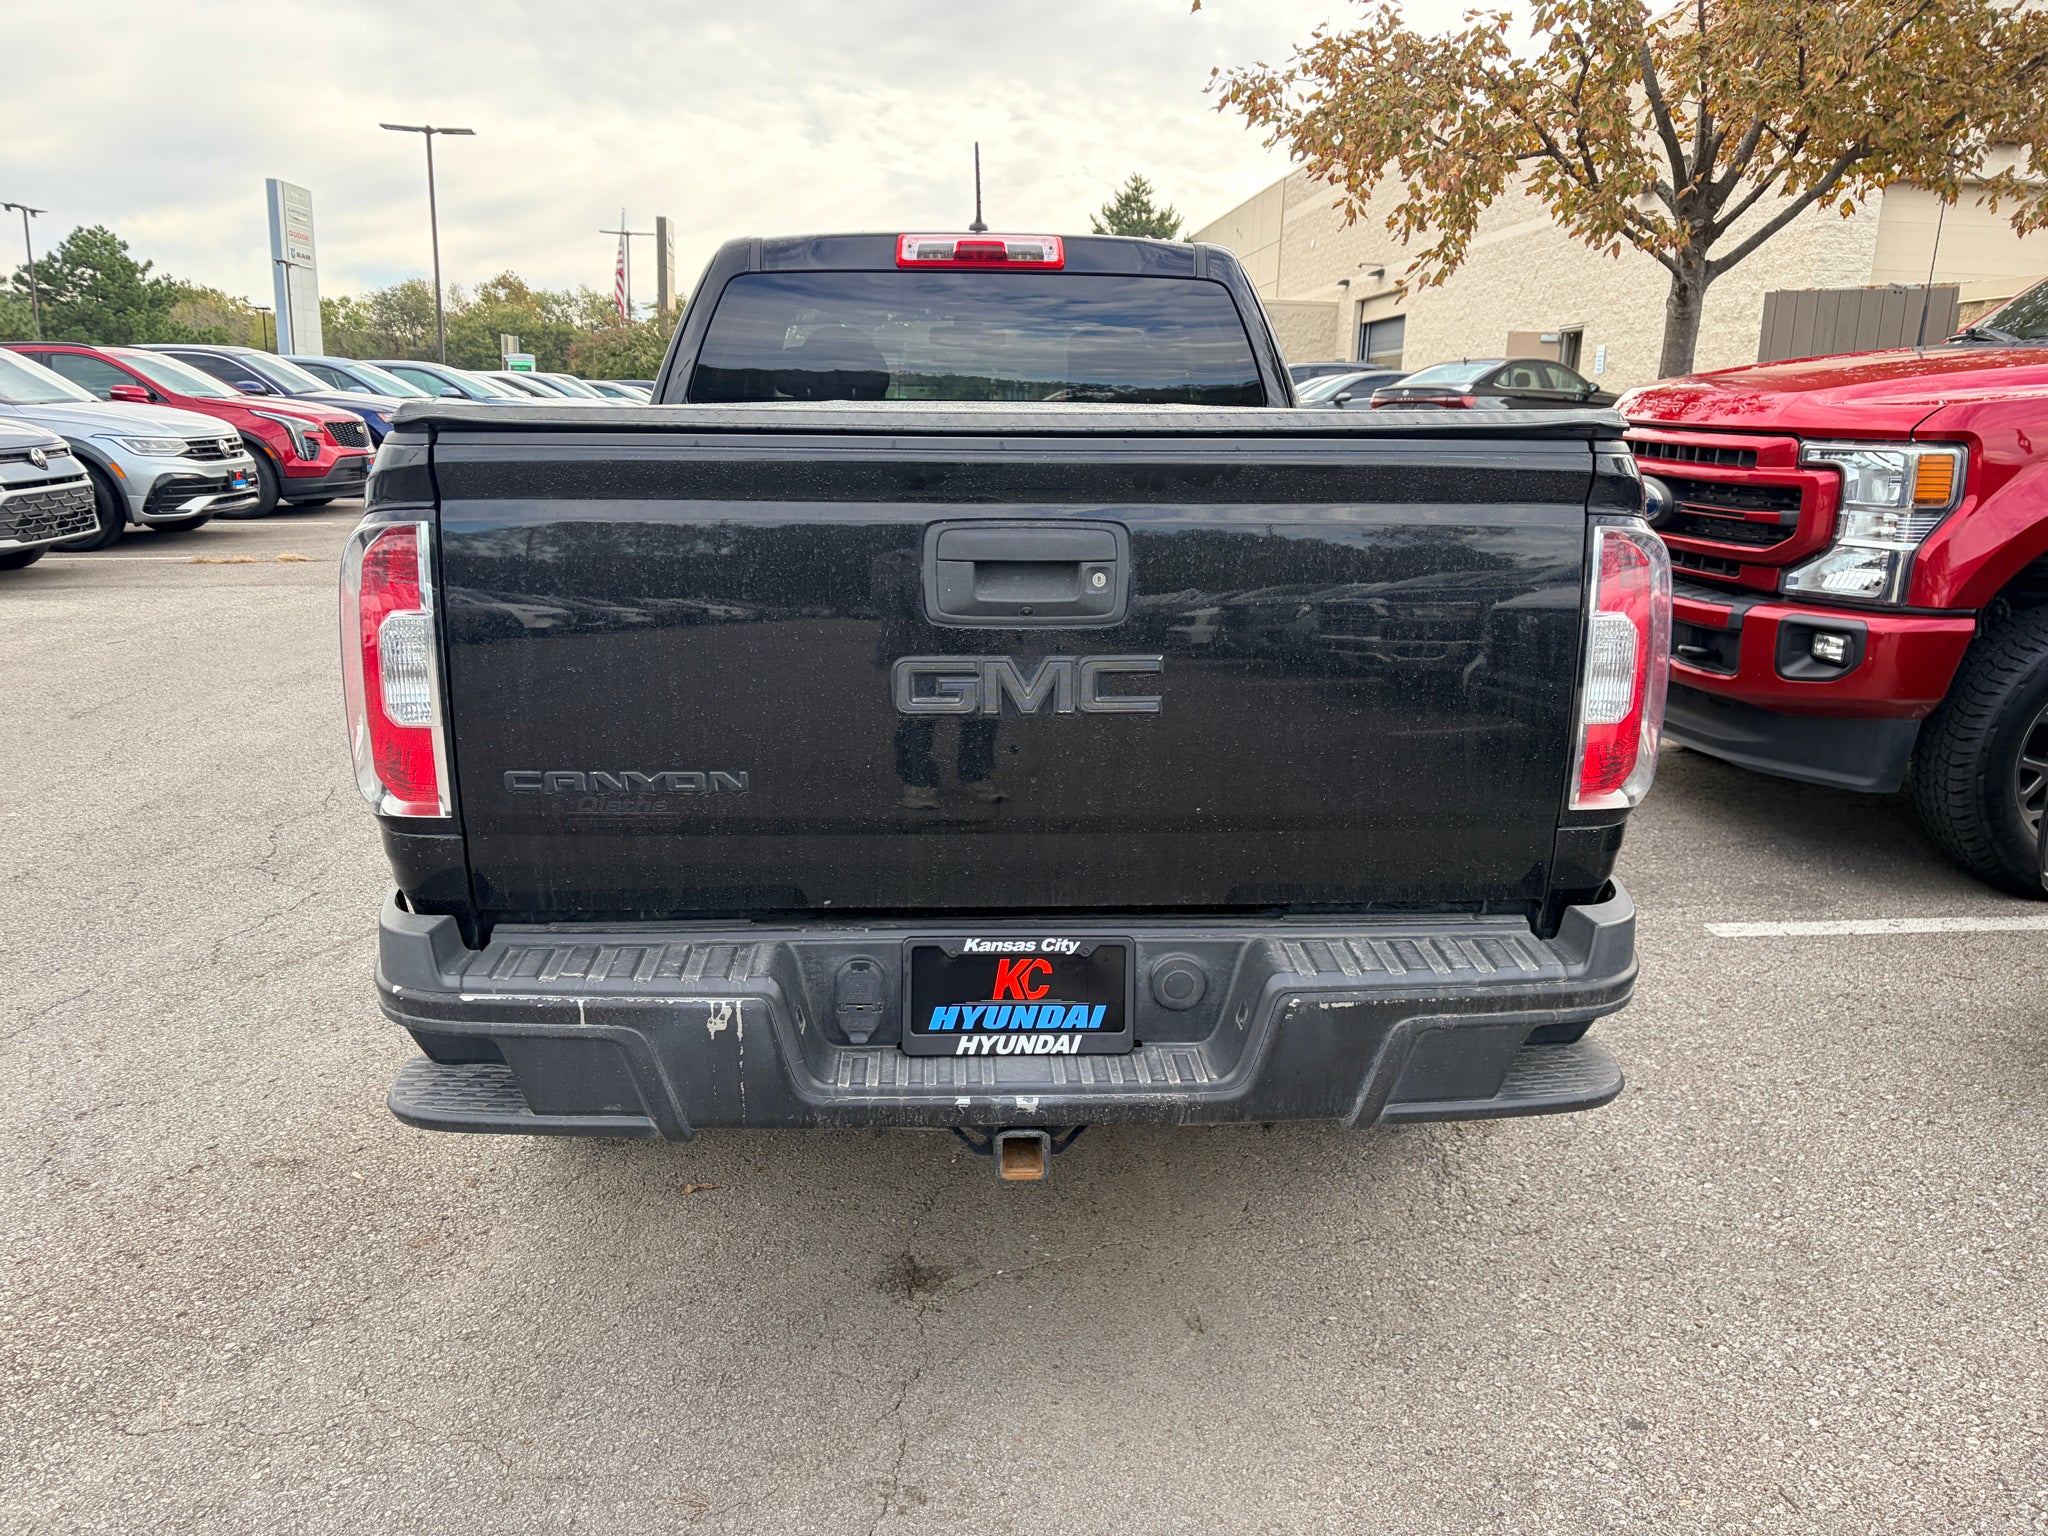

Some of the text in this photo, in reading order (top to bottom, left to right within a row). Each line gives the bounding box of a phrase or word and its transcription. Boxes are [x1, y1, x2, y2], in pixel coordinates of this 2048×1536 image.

[288, 230, 310, 242] DODGE
[296, 251, 311, 261] RAM
[891, 655, 1164, 715] GMC
[503, 770, 749, 793] CANYON
[963, 938, 1081, 955] Kansas City
[992, 958, 1054, 1001] KC
[928, 1004, 1107, 1031] HYUNDAI
[955, 1034, 1083, 1056] HYUNDAI
